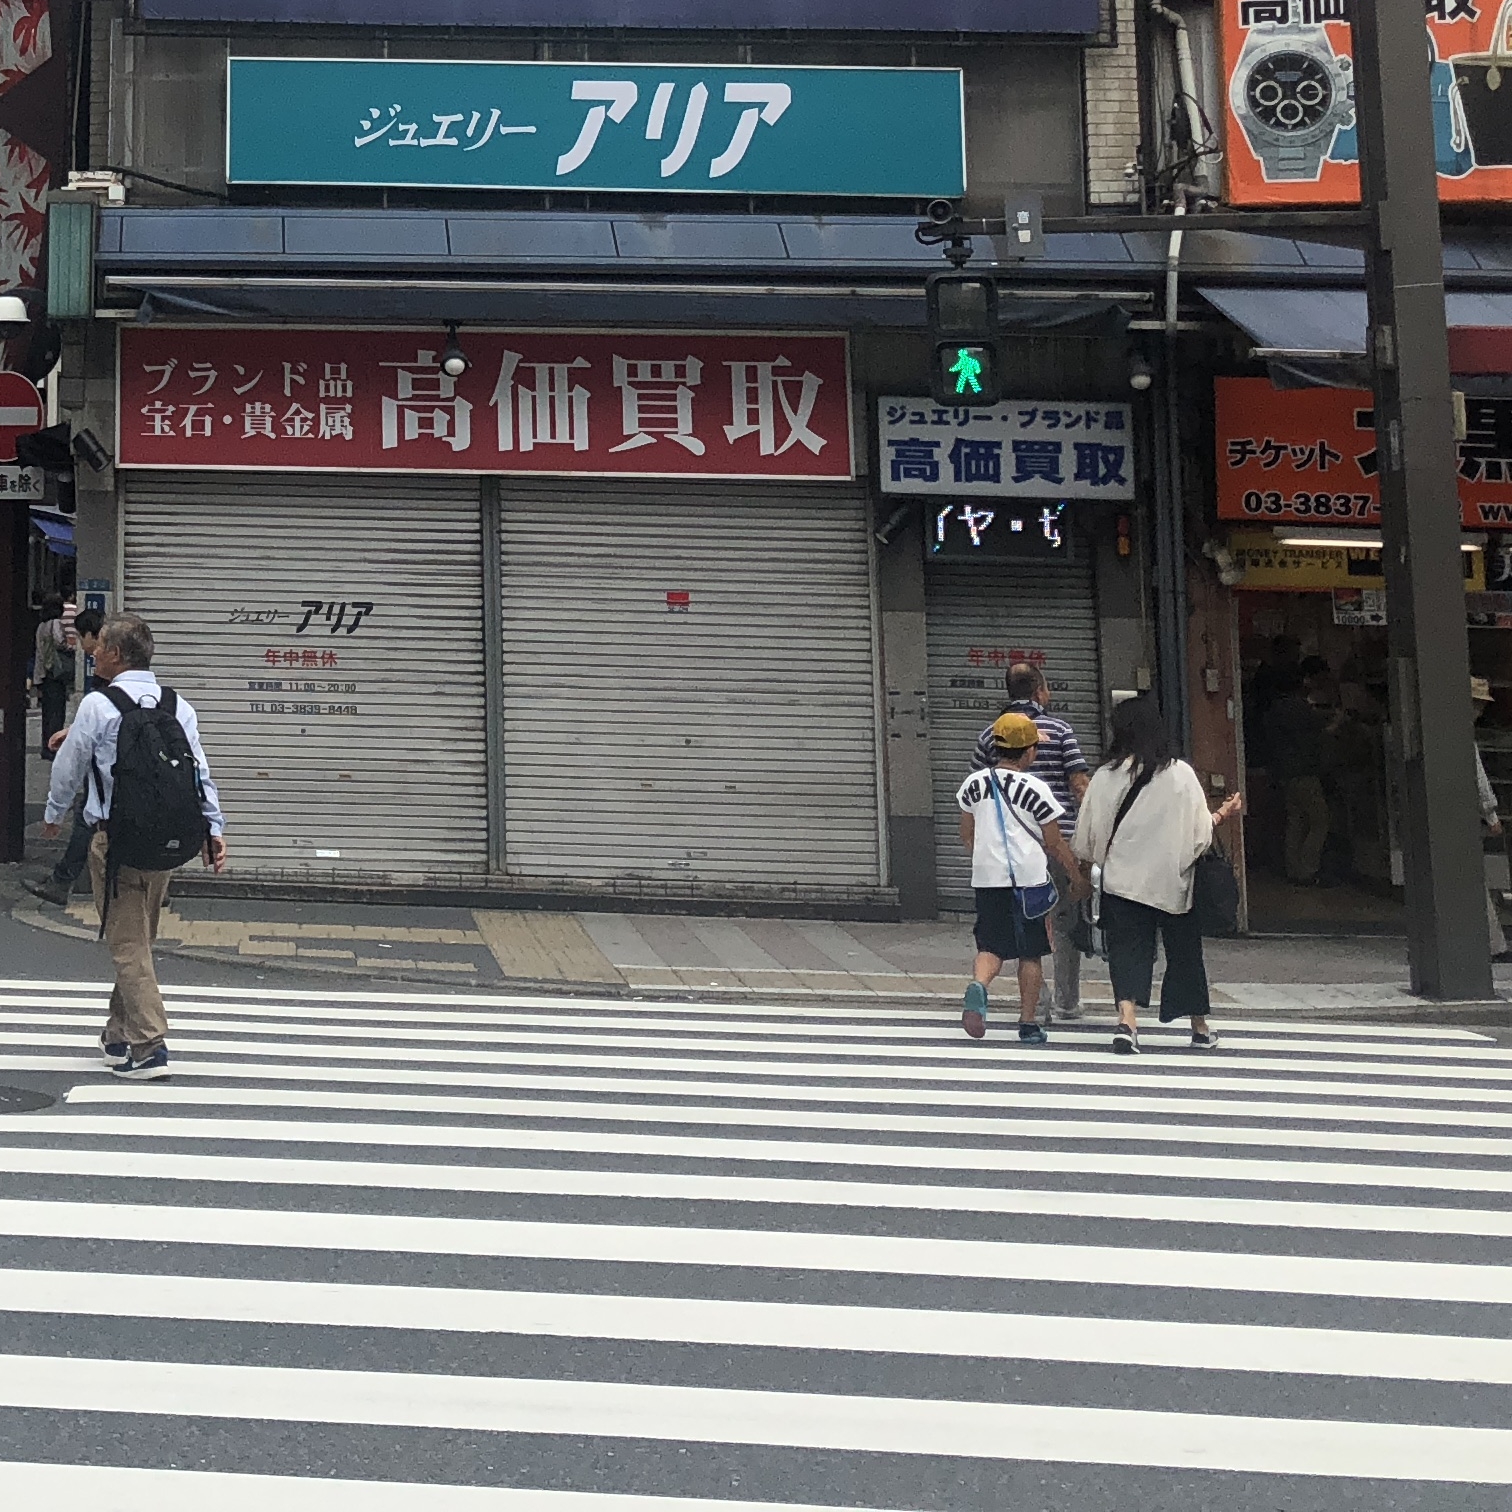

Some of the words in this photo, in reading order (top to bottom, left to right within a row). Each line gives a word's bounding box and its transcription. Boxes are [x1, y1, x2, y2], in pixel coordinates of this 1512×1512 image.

[354, 102, 537, 152] ジュエリー
[554, 80, 792, 178] アリア
[142, 360, 354, 399] ブランド品
[139, 402, 355, 441] 宝石・貴金属
[378, 349, 830, 456] 高価買取
[886, 405, 1126, 432] ジュエリー・ブランド品
[886, 436, 1128, 487] 高価買取
[1226, 437, 1343, 471] チケット
[228, 606, 289, 624] ジュエリー
[296, 600, 374, 635] アリア
[264, 648, 338, 668] 年中無休
[249, 702, 267, 713] TEL
